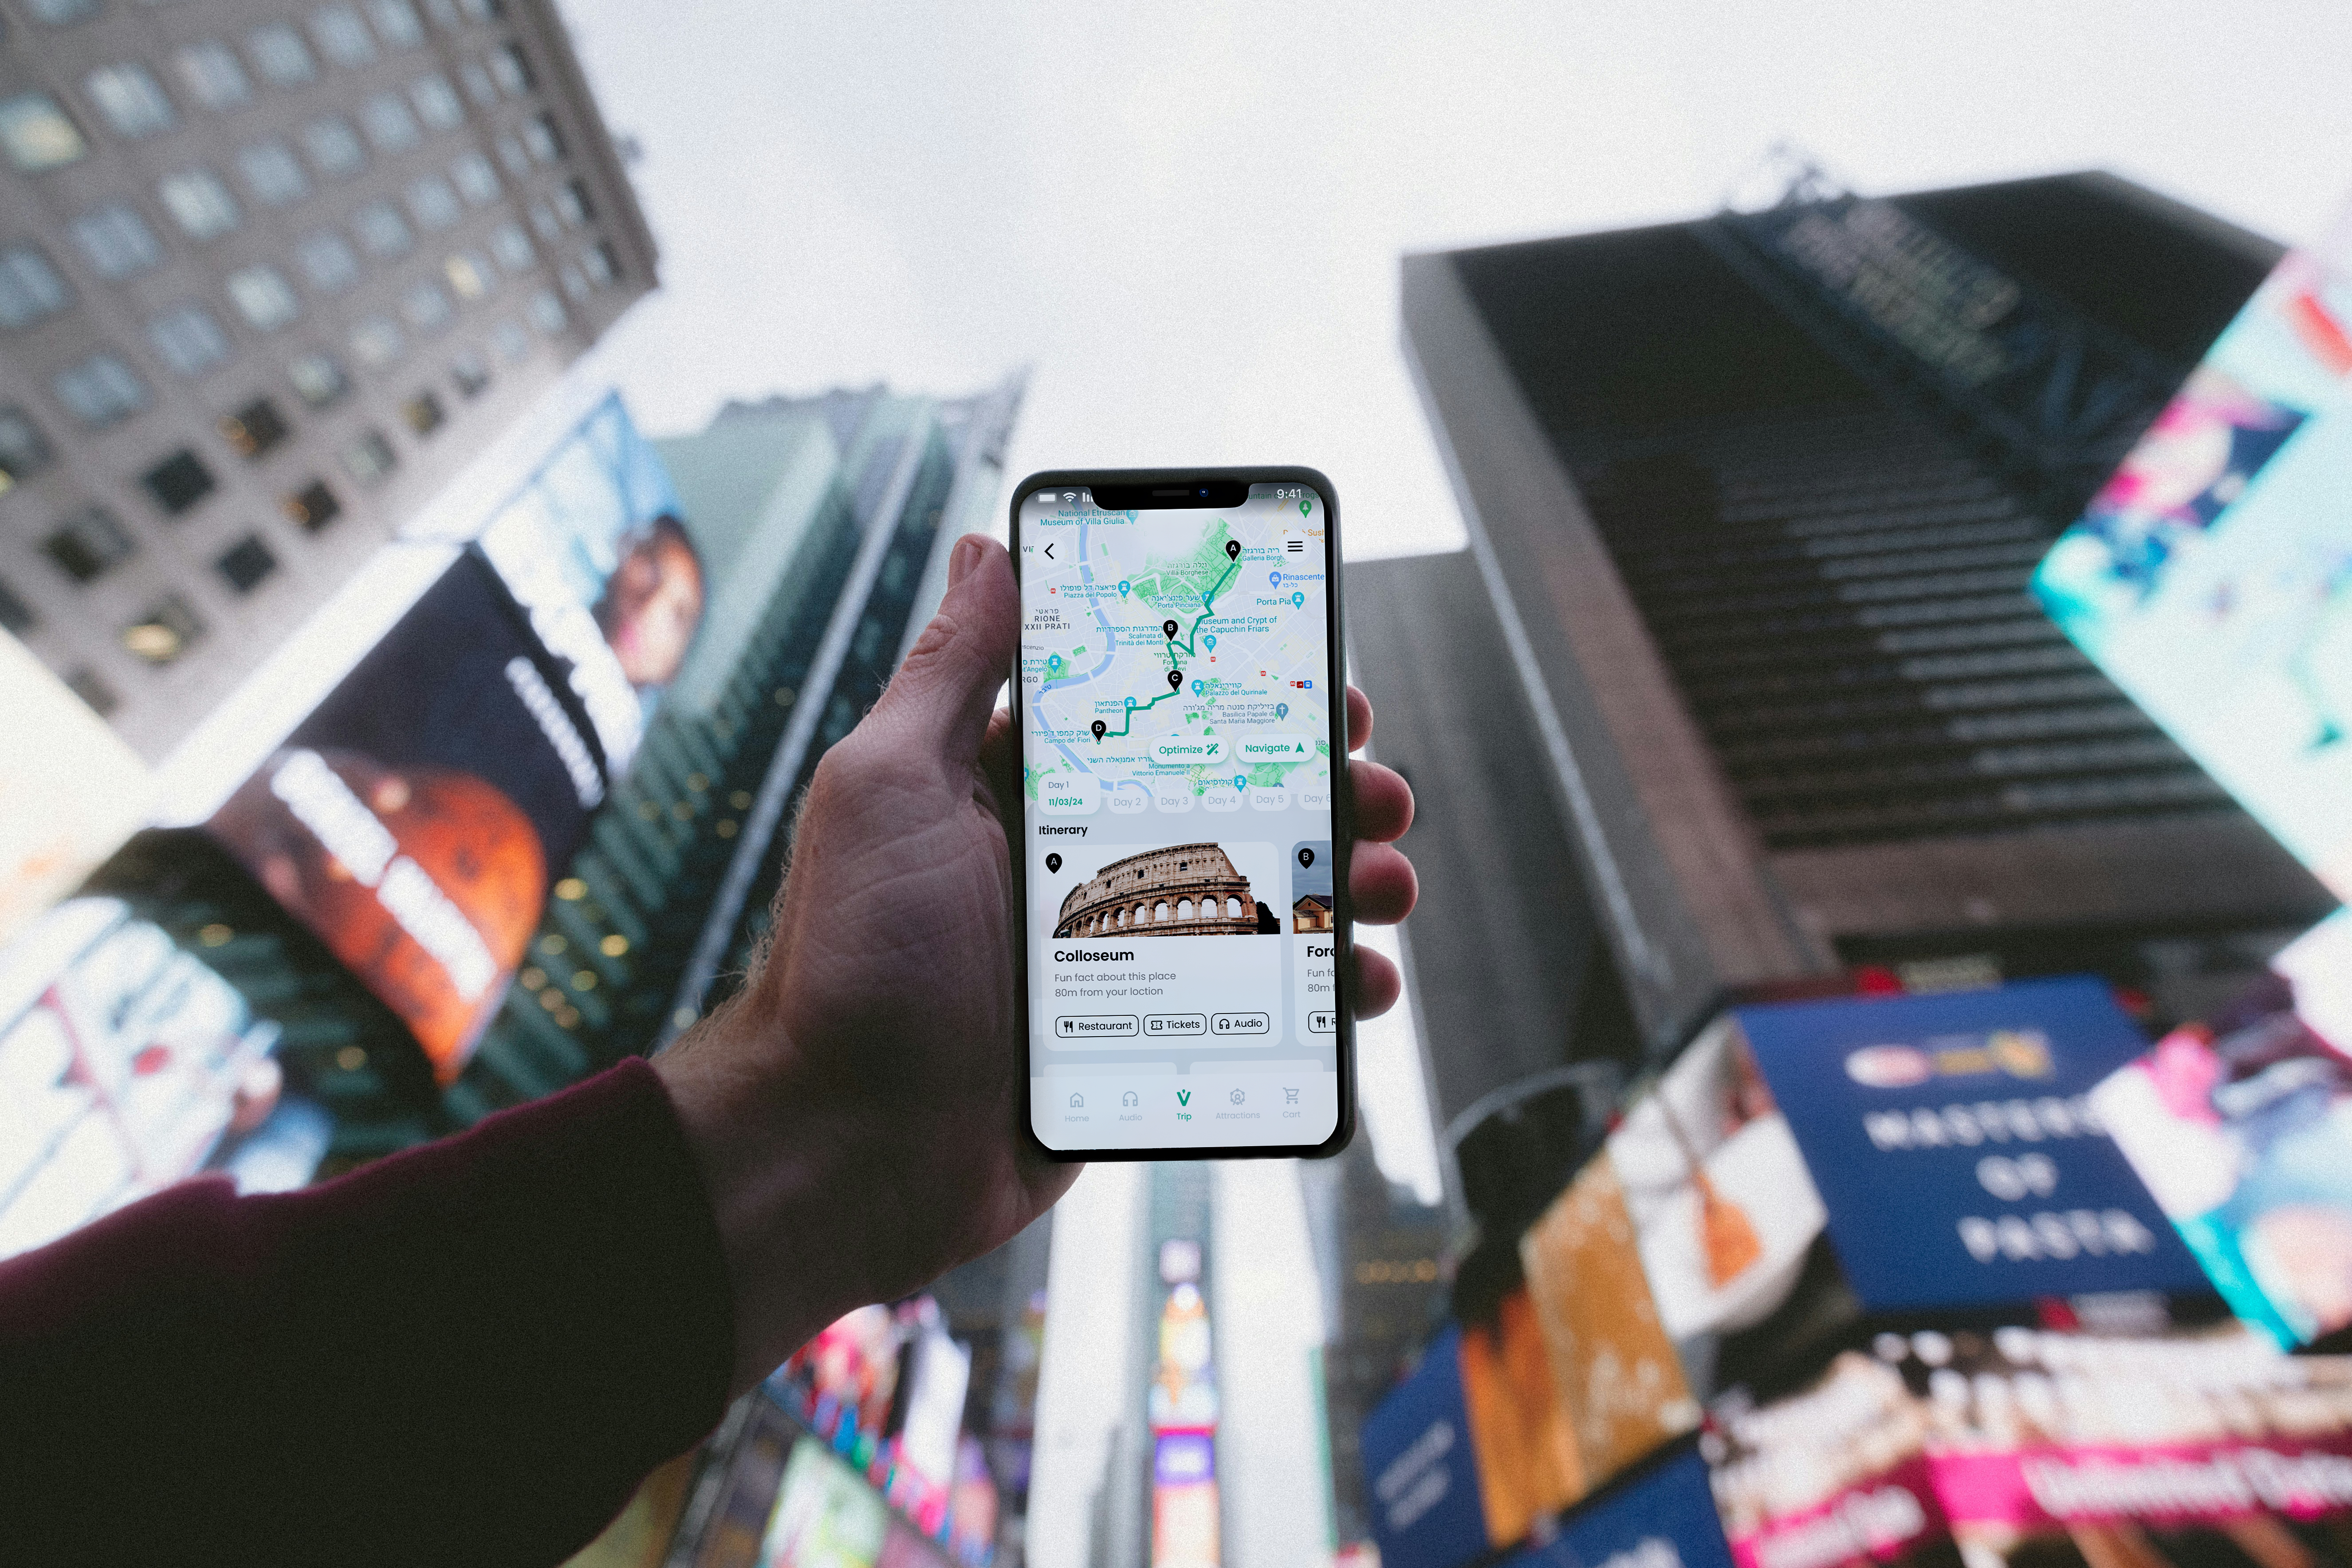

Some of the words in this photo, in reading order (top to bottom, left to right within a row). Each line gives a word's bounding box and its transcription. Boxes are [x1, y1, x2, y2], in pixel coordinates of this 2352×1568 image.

[1277, 489, 1301, 499] 9:41
[1247, 617, 1267, 625] Crypt
[1159, 745, 1203, 756] Optimize
[1246, 743, 1290, 755] Navigate
[1048, 782, 1064, 790] Day
[1198, 778, 1232, 786] קולוסיאום
[1049, 797, 1083, 807] 11/03/24
[1114, 798, 1133, 808] Day
[1161, 798, 1180, 807] Day
[1208, 796, 1227, 806] Day
[1257, 795, 1275, 806] Day
[1305, 795, 1323, 804] Day
[1039, 825, 1088, 837] Itinerary
[1054, 950, 1134, 962] Colloseum
[1149, 972, 1176, 982] place
[1055, 989, 1077, 997] 80m
[1105, 989, 1127, 998] your
[1130, 987, 1163, 995] loction
[1308, 984, 1329, 992] 80m
[1079, 1022, 1132, 1030] Restaurant
[1167, 1020, 1200, 1029] Tickets
[1235, 1019, 1263, 1028] Audio
[1176, 1113, 1192, 1122] Trip
